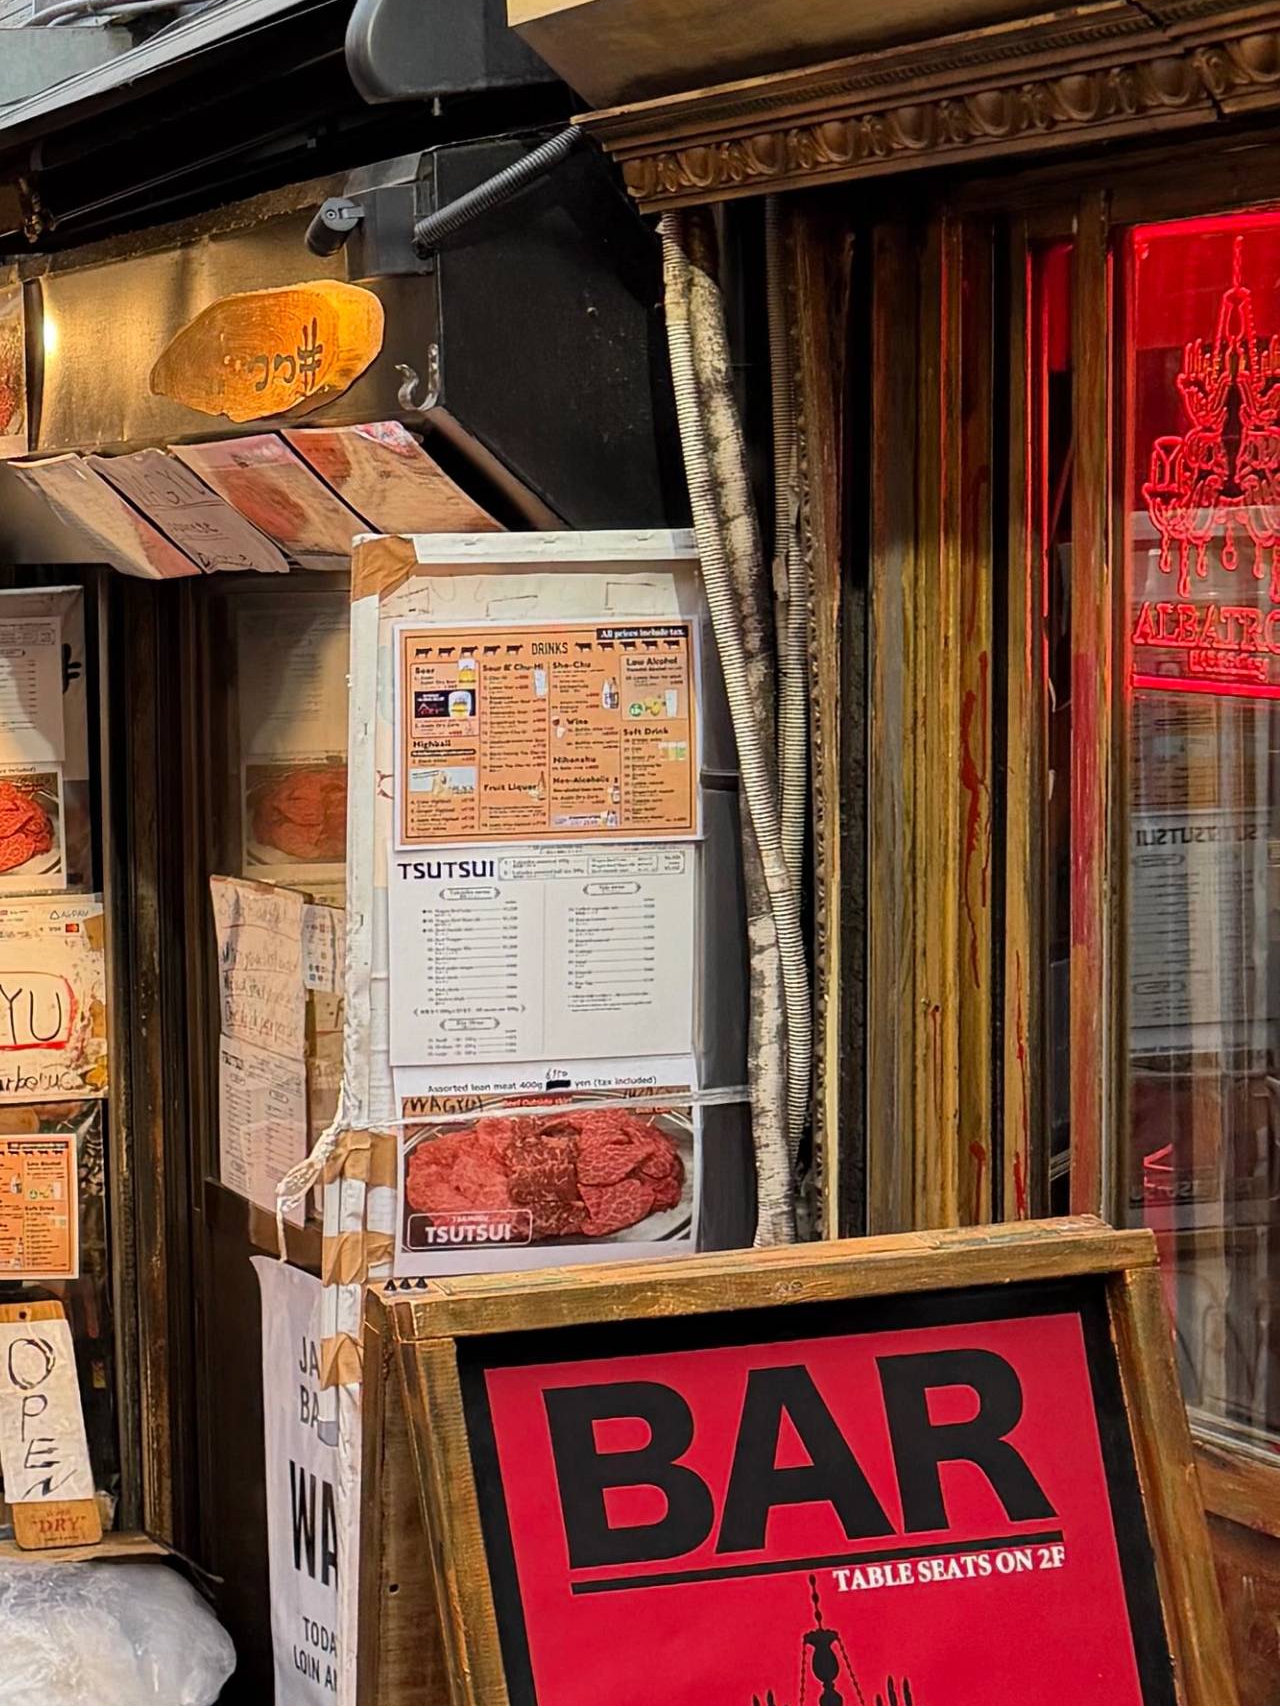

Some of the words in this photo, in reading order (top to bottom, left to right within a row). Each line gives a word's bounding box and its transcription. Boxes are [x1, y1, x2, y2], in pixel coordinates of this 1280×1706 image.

[531, 642, 569, 656] DRINKS
[552, 661, 592, 670] Sho-Chu
[626, 657, 646, 667] Low
[647, 656, 679, 666] Alcohol
[414, 666, 436, 676] Beer
[482, 664, 503, 673] Sour
[566, 718, 589, 726] Wine
[623, 727, 643, 736] Soft
[644, 726, 669, 736] Drink
[412, 739, 452, 752] Highball
[483, 784, 507, 792] Fruit
[507, 782, 538, 794] Liquor
[398, 860, 495, 880] TSUTSUI
[427, 1082, 470, 1093] Assorted
[470, 1081, 491, 1091] lean
[493, 1080, 518, 1090] meat
[574, 1078, 593, 1088] yen
[593, 1077, 613, 1087] (tax
[614, 1075, 658, 1086] included)
[424, 1224, 512, 1244] TSUTSUI
[7, 1337, 78, 1500] OPEN
[540, 1345, 1061, 1572] BAR
[831, 1563, 915, 1593] TABLE
[917, 1555, 992, 1584] SEATS
[994, 1548, 1034, 1575] ON
[1036, 1544, 1066, 1570] 2F
[293, 1643, 321, 1681] LOIN
